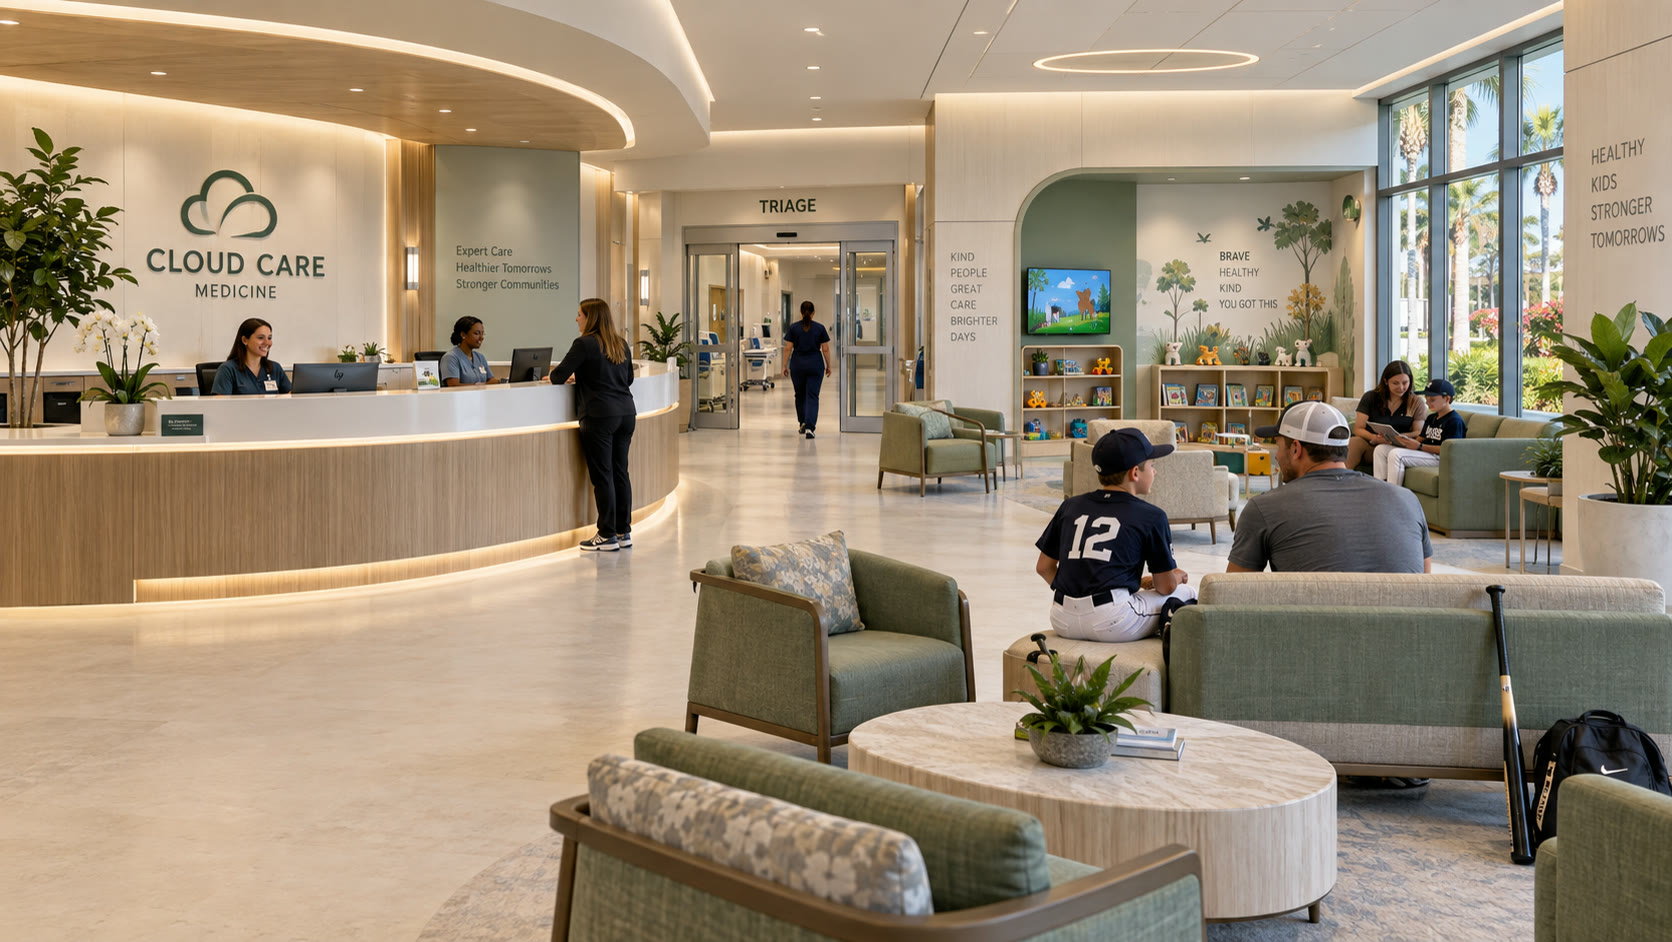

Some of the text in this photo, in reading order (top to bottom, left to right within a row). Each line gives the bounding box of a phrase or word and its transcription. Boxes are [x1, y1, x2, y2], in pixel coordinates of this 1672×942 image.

[1591, 137, 1645, 165] HEALTHY
[1591, 173, 1617, 192] KIDS
[759, 199, 817, 214] TRIAGE
[1591, 196, 1653, 221] STRONGER
[1591, 225, 1665, 249] TOMORROWS
[456, 245, 513, 258] Expert Care
[950, 251, 975, 262] KIND
[1219, 251, 1251, 261] BRAVE
[147, 248, 326, 278] CLOUD CARE
[456, 262, 552, 274] Healthier Tomorrows
[950, 267, 988, 278] PEOPLE
[1219, 267, 1260, 278] HEALTHY
[195, 283, 277, 299] MEDICINE
[456, 278, 560, 292] Stronger Communities
[950, 283, 983, 294] GREAT
[1219, 283, 1242, 293] KIND
[950, 299, 977, 310] CARE
[1219, 299, 1278, 309] YOU GOT THIS
[950, 315, 998, 326] BRIGHTER
[950, 331, 977, 342] DAYS
[1068, 514, 1121, 562] 12
